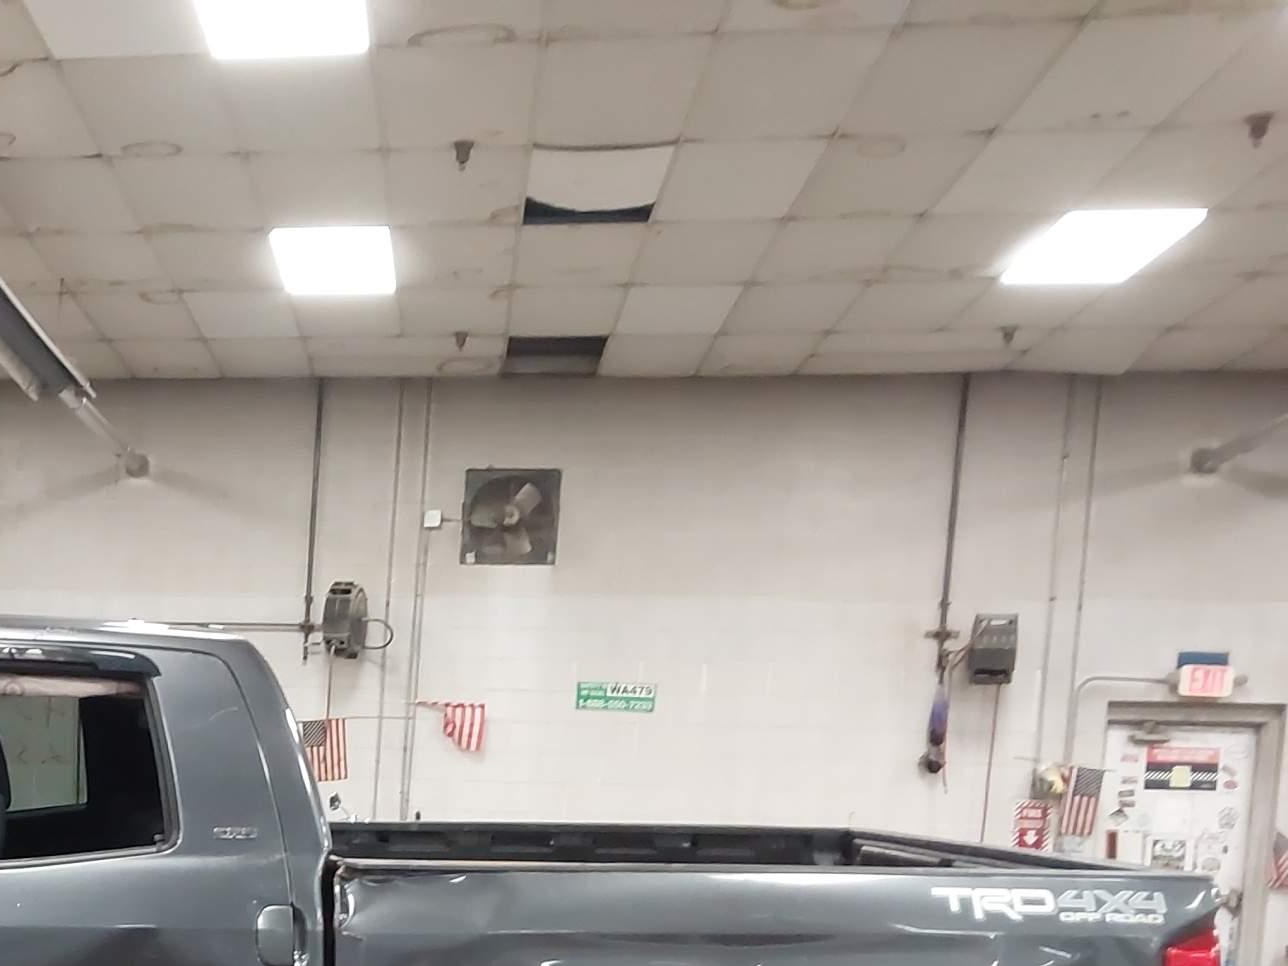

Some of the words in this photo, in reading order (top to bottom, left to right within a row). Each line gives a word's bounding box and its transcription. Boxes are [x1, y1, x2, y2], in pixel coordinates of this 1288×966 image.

[1190, 667, 1227, 694] EXIT
[930, 887, 1058, 922] TRD
[1058, 912, 1102, 923] OFF
[1105, 913, 1165, 925] ROAD
